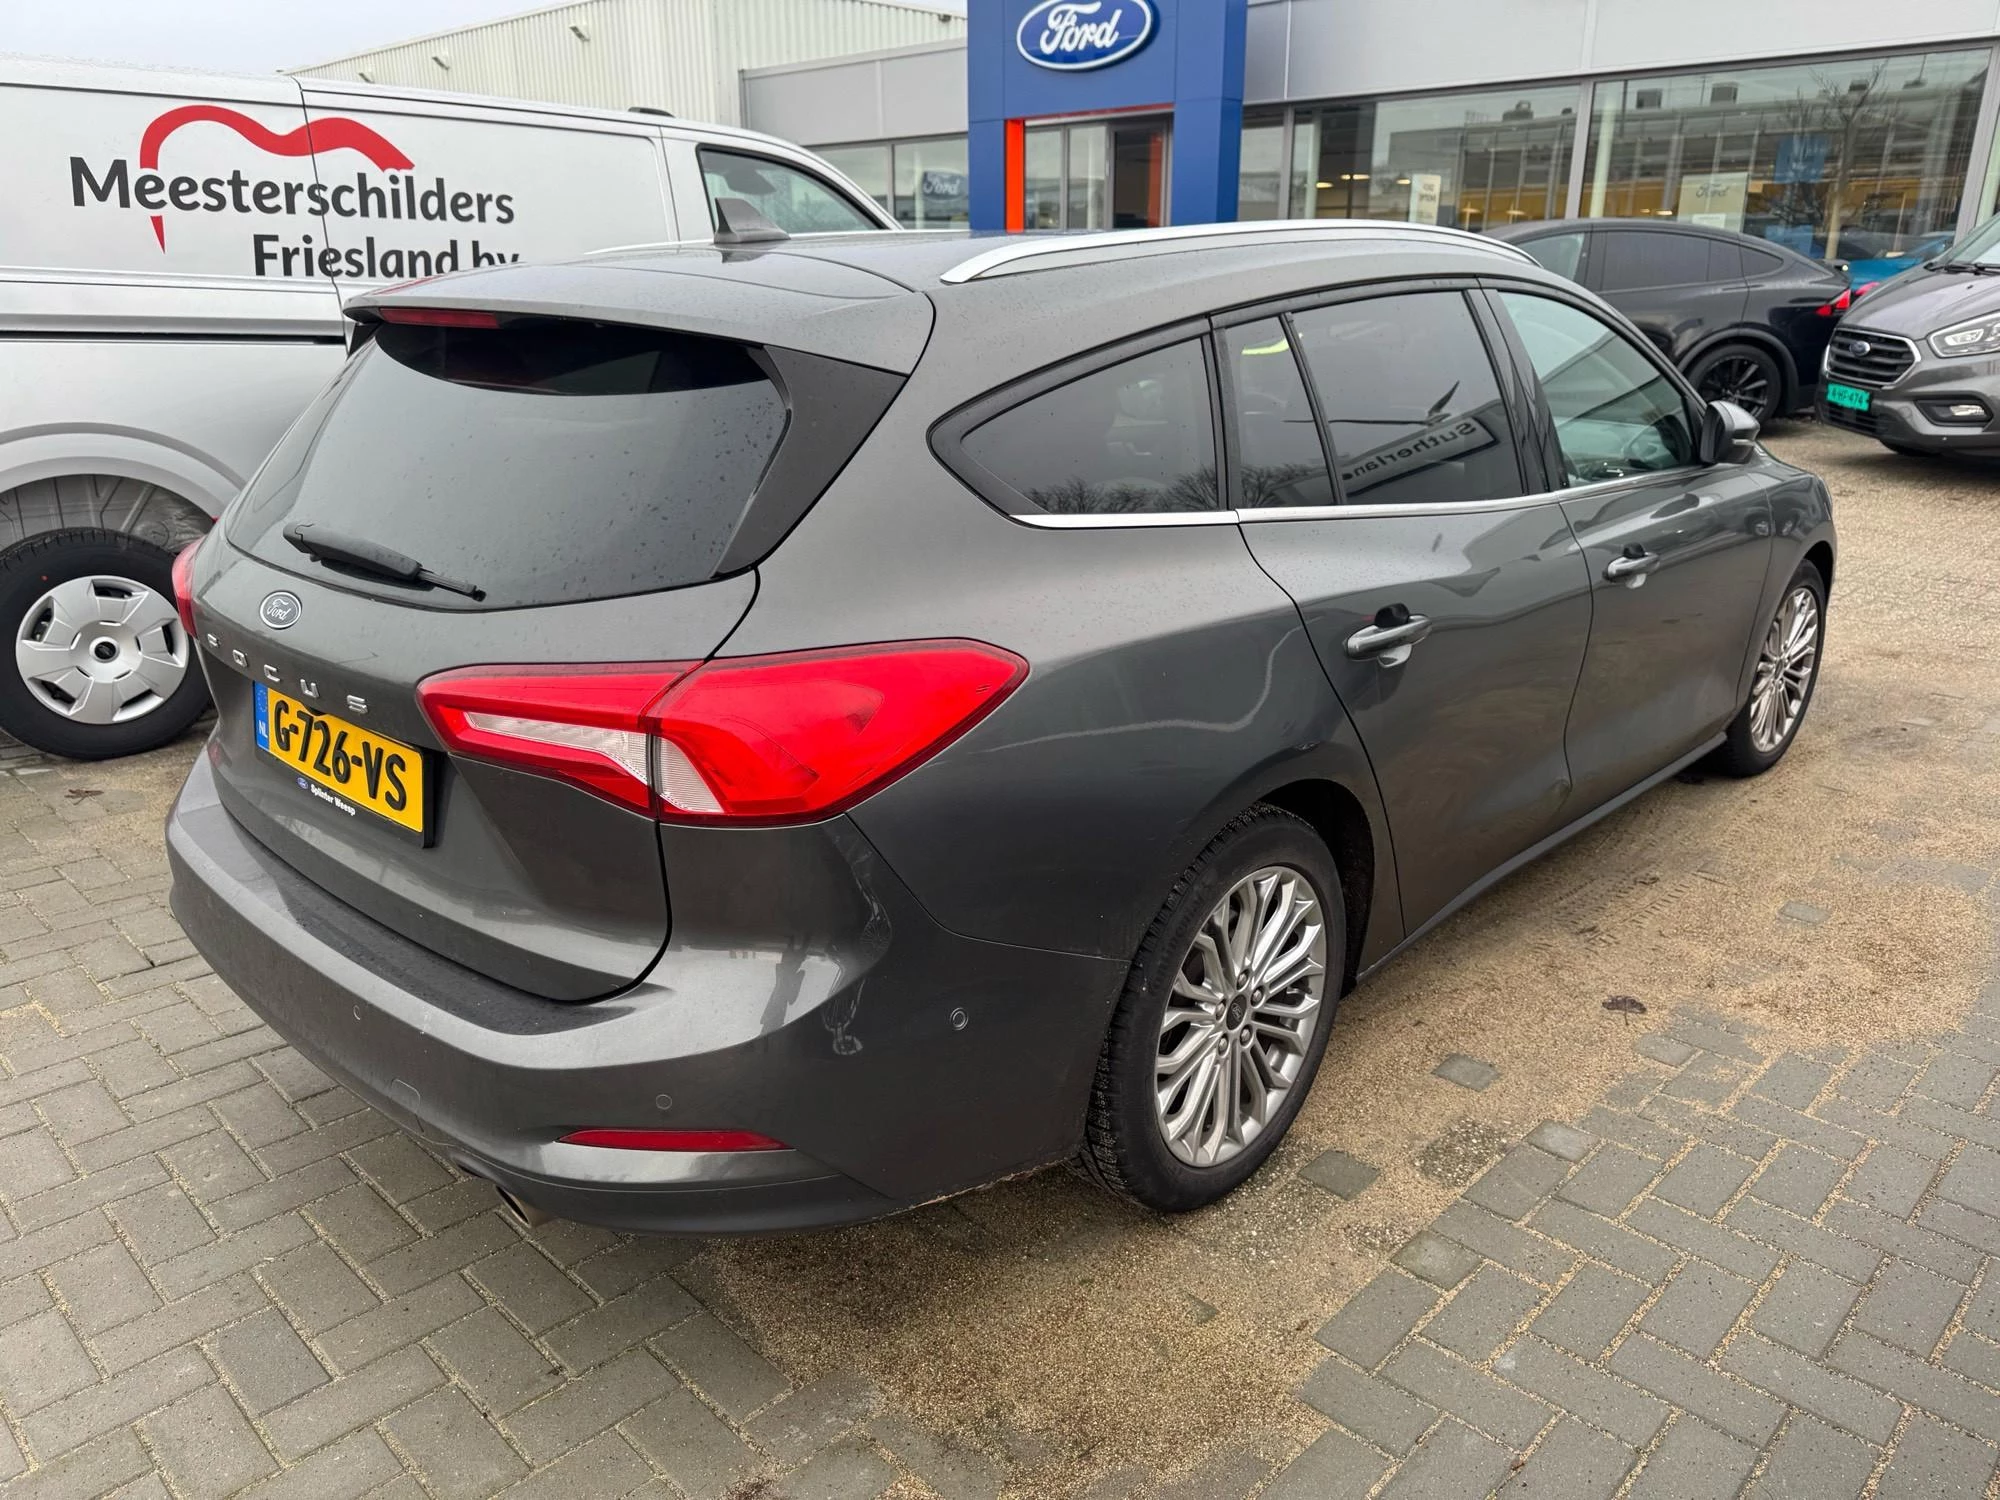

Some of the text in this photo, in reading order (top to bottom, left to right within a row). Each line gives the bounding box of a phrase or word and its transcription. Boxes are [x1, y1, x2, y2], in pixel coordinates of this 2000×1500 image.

[1040, 1, 1123, 55] Ford
[70, 156, 515, 224] Meesterschilders
[923, 172, 961, 196] Ford
[253, 233, 459, 278] Friesland
[266, 598, 292, 621] Ford
[207, 633, 368, 714] FOCUS
[258, 719, 268, 738] NL
[274, 699, 407, 812] G-726-VS
